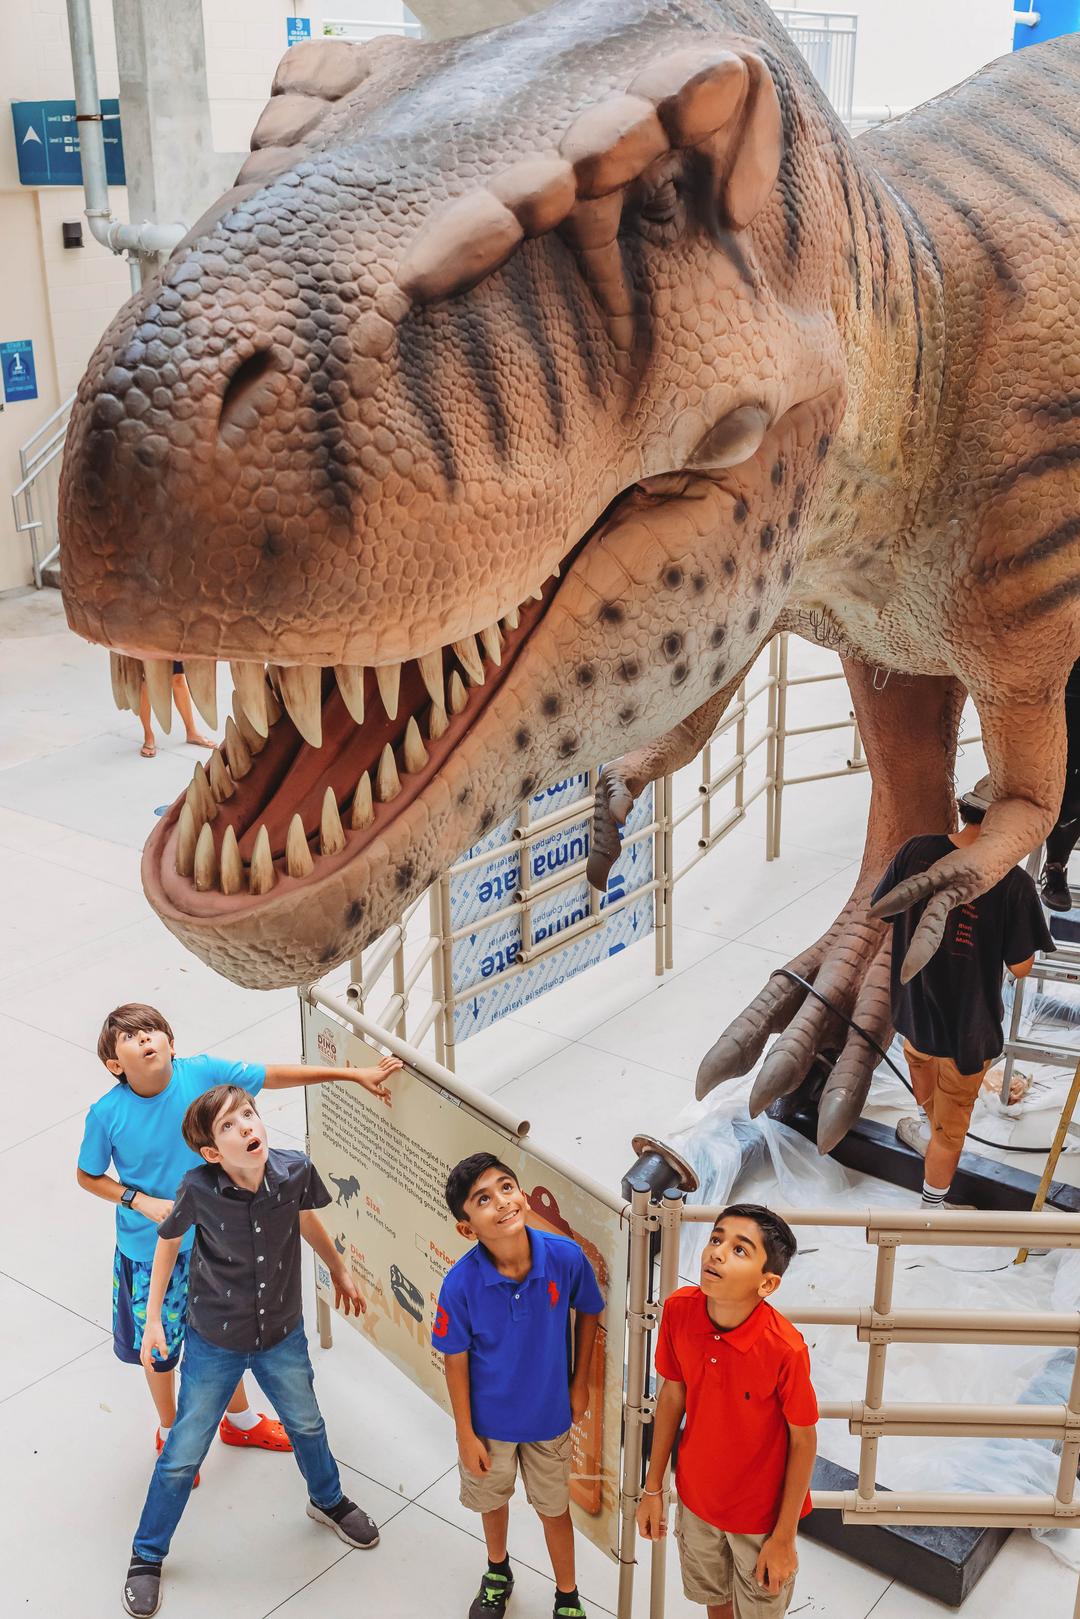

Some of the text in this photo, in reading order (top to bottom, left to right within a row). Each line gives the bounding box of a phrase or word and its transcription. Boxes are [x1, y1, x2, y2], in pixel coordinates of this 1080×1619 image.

[13, 352, 23, 370] 1
[486, 851, 520, 874] Material
[490, 955, 601, 1021] Aluminum Composite Material
[317, 1034, 337, 1055] DINO
[345, 1089, 364, 1111] hunting
[410, 1141, 438, 1166] entangled
[360, 1110, 375, 1129] injury
[352, 1115, 378, 1141] struggling
[413, 1160, 432, 1181] Rescue
[371, 1159, 396, 1183] entangled
[404, 1183, 422, 1204] fishing
[415, 1181, 432, 1200] North
[366, 1196, 381, 1215] Size
[351, 1244, 366, 1263] Diet
